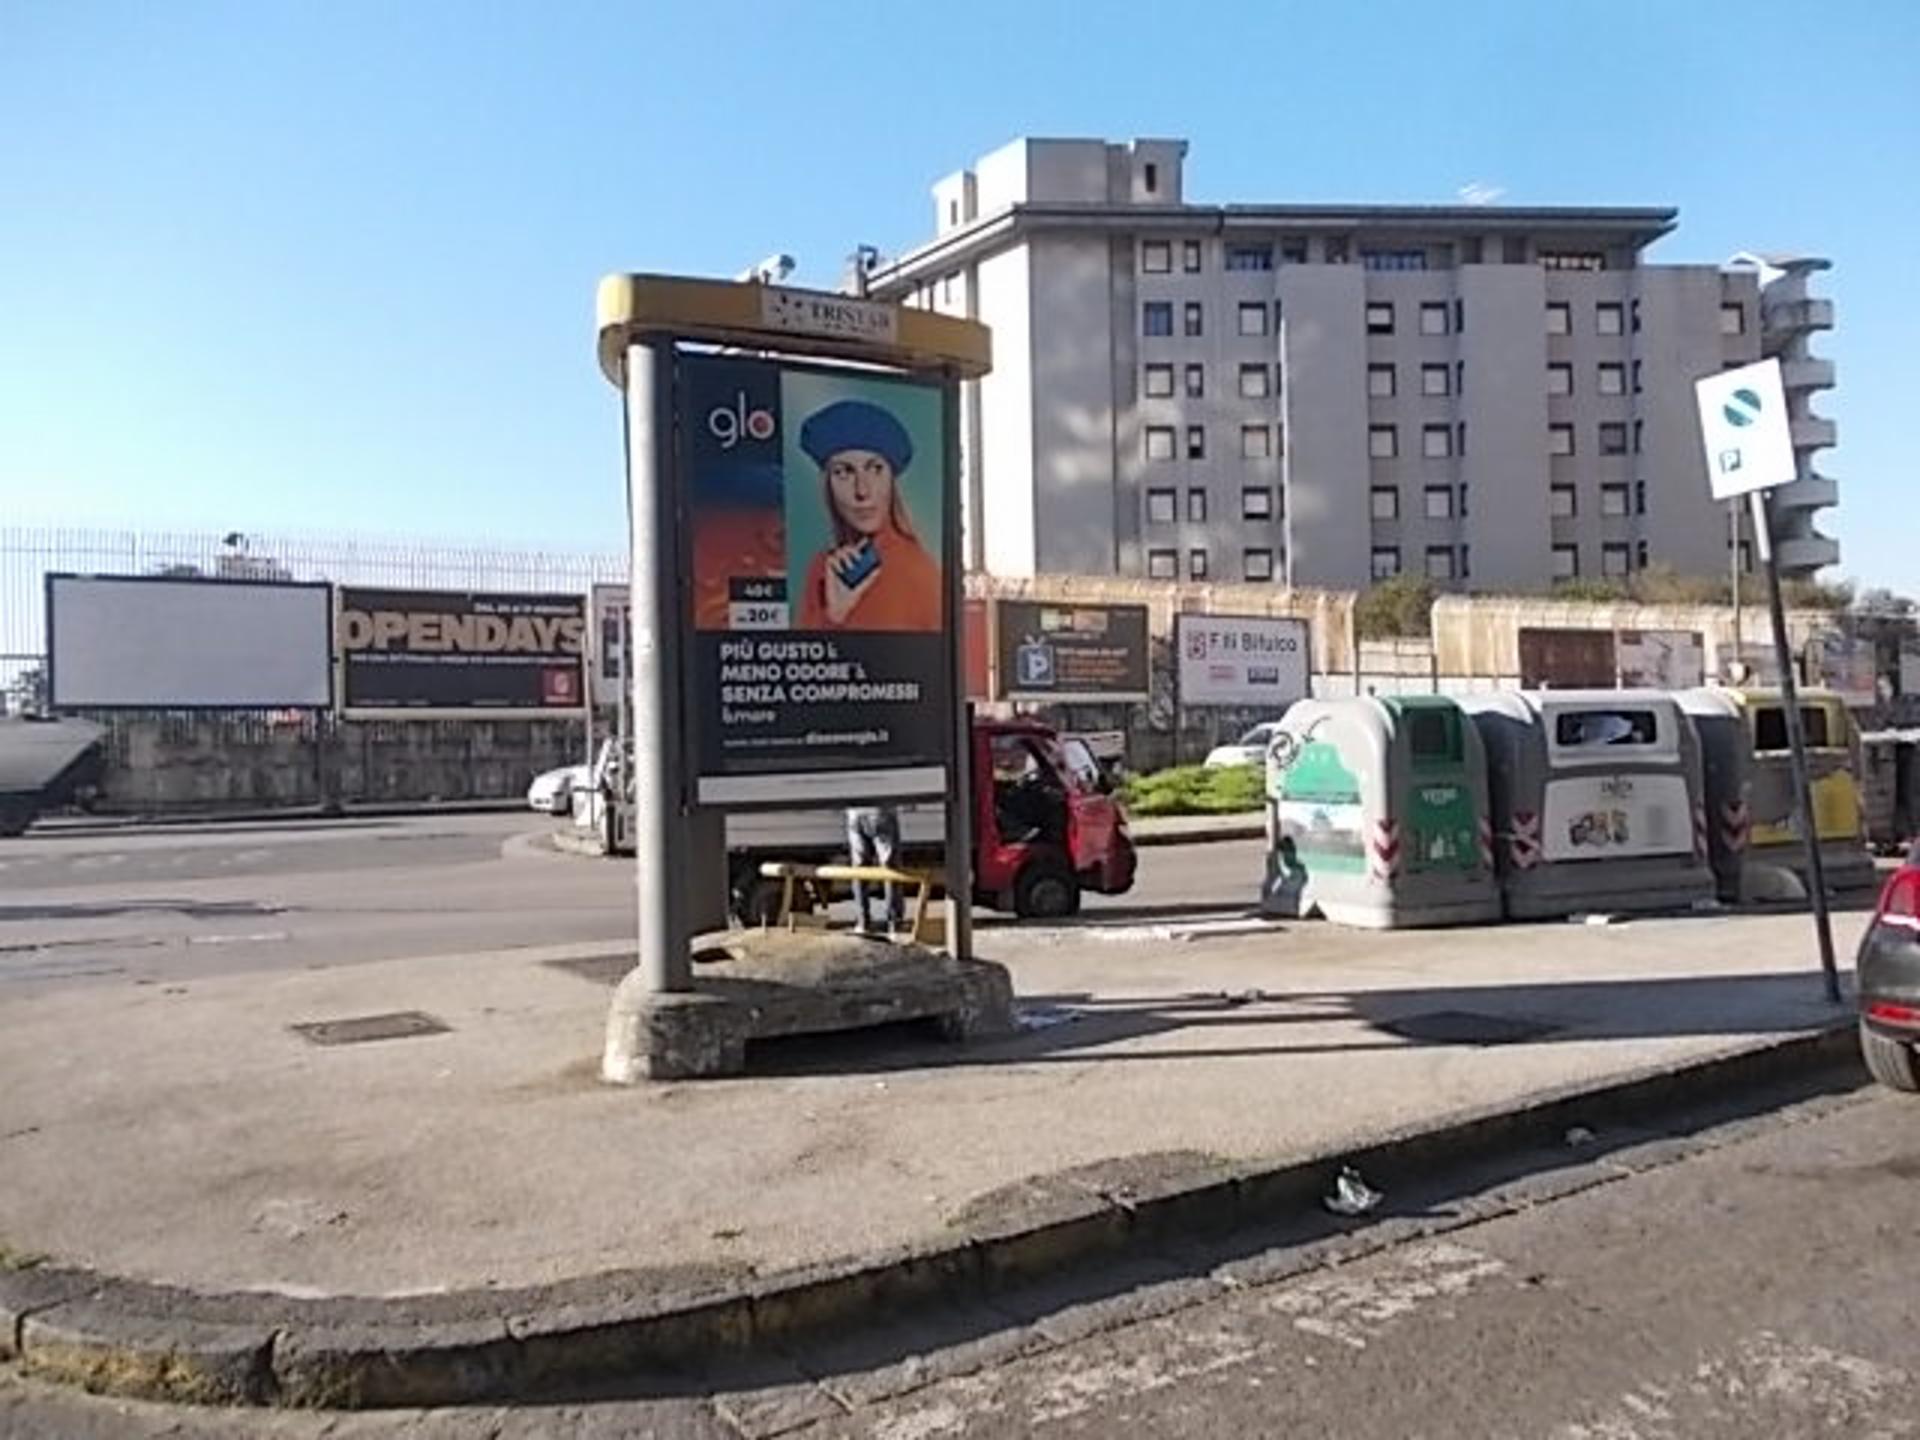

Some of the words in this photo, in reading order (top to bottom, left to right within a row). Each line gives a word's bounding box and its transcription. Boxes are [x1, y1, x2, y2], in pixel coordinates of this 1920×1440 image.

[708, 391, 776, 449] glo
[720, 638, 754, 660] PIÙ
[757, 642, 825, 660] GUSTO
[721, 663, 781, 682] MENO
[785, 662, 850, 681] ODORE
[721, 684, 786, 704] SENZA
[789, 682, 920, 702] COMPROMESSI
